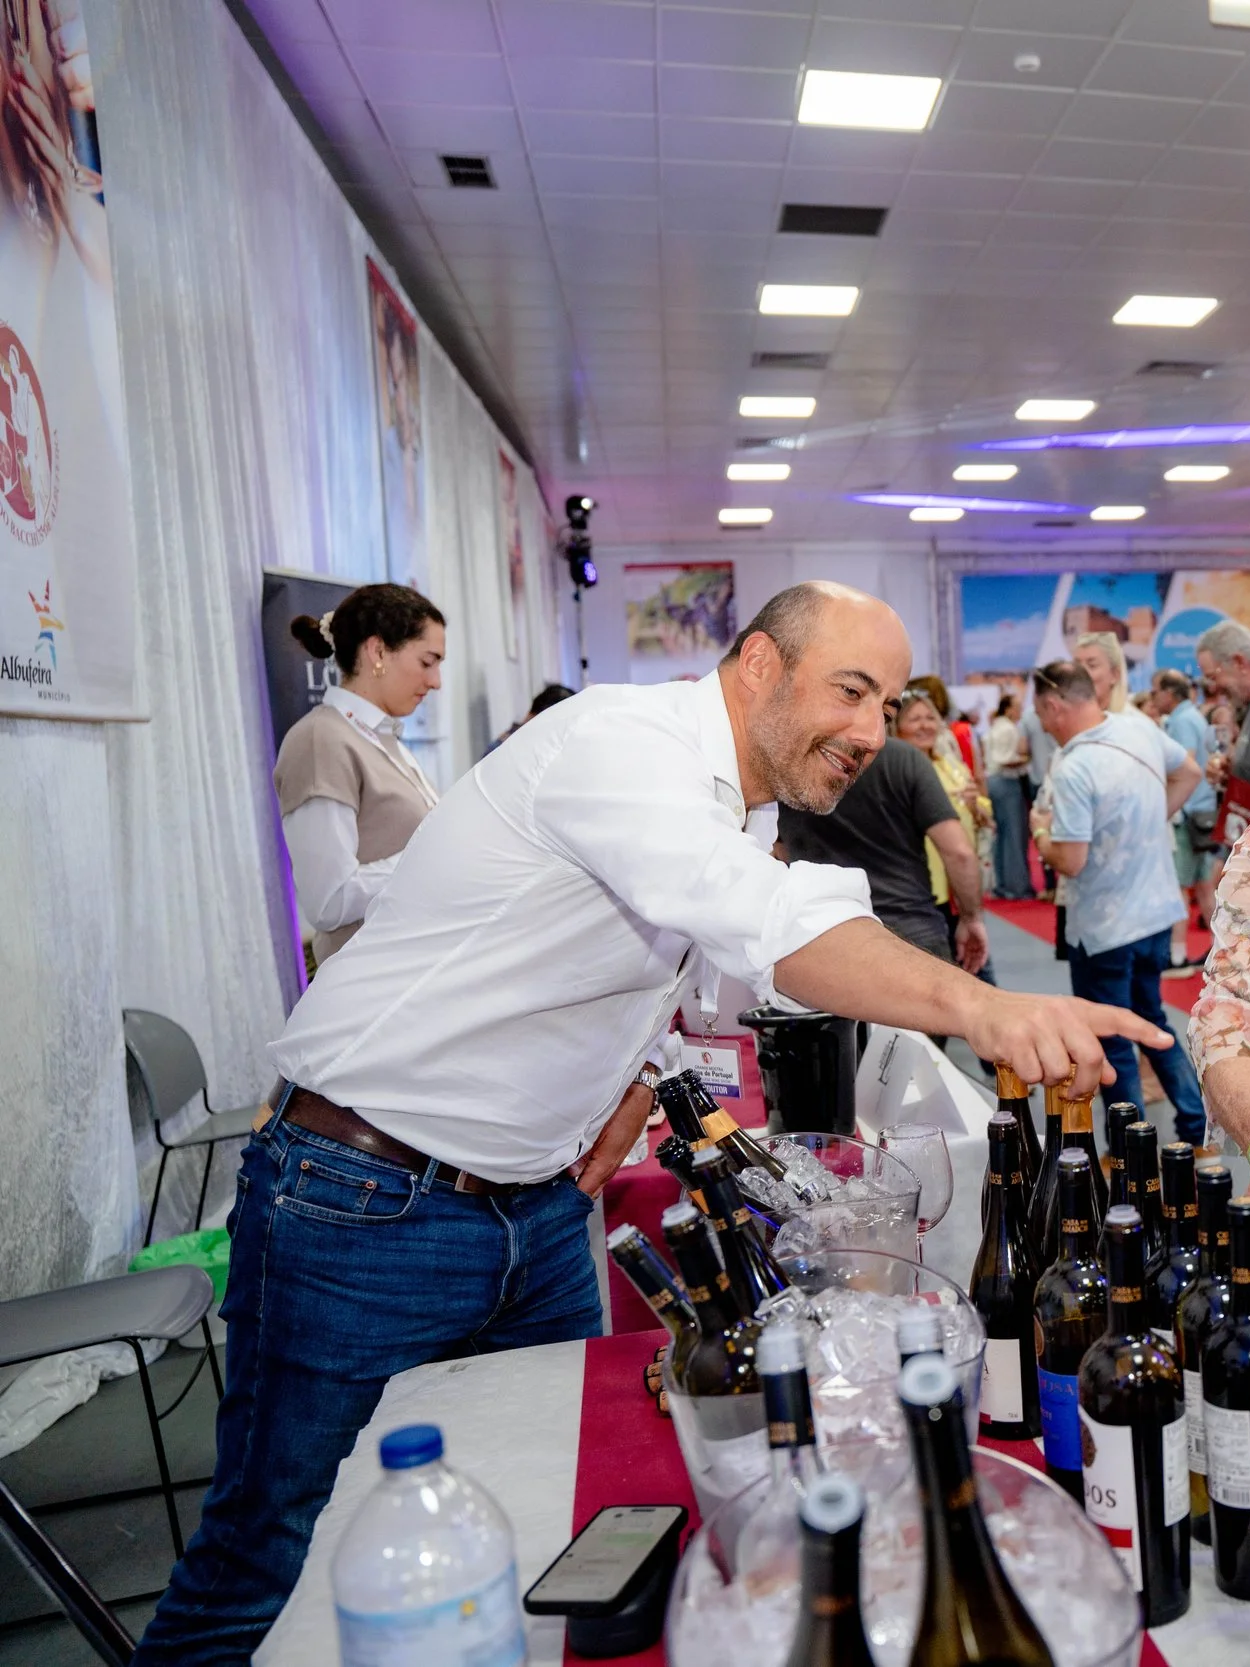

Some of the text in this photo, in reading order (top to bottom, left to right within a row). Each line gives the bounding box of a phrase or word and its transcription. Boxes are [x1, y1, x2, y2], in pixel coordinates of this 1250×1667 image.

[0, 656, 52, 688] Albufeira
[712, 1071, 733, 1079] Portugal
[706, 1084, 728, 1095] DUTOR
